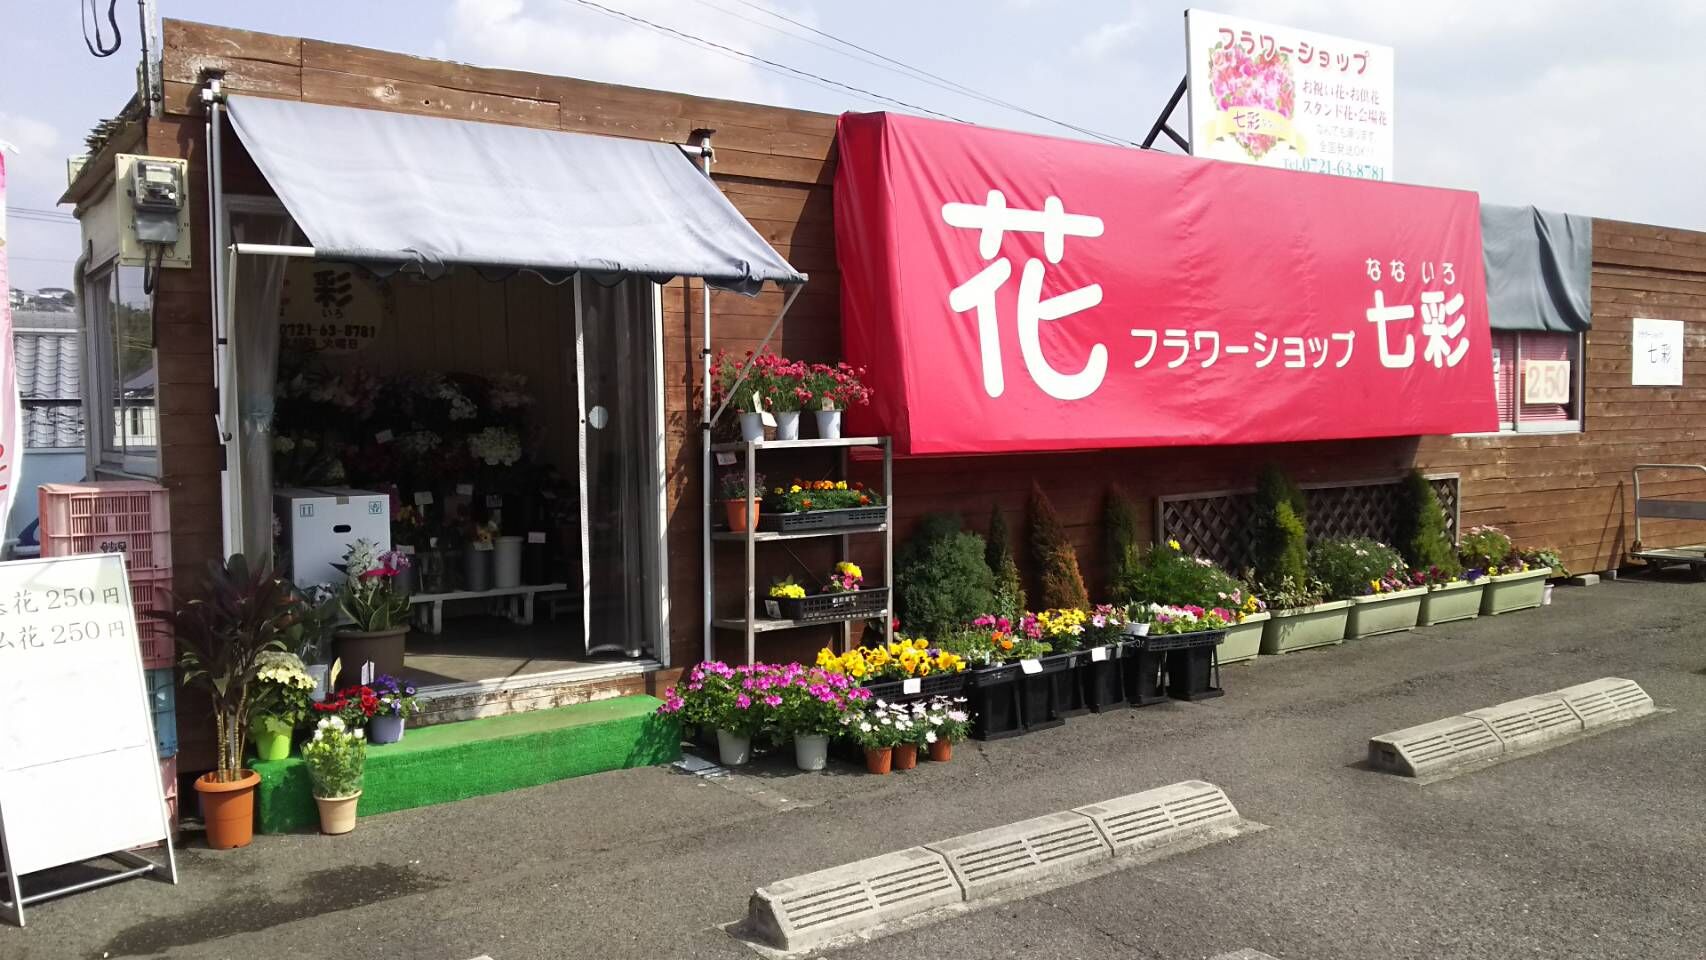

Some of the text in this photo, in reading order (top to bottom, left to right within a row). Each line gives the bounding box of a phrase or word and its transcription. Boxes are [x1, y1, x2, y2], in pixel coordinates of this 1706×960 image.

[1218, 27, 1370, 75] フラワーショップ
[1232, 109, 1261, 130] 七彩
[941, 189, 1108, 400] 花
[1130, 327, 1356, 369] フラワーショップ
[1366, 290, 1470, 369] 七彩
[1647, 343, 1673, 367] 七彩
[1528, 364, 1568, 400] 250
[0, 589, 39, 615] 花
